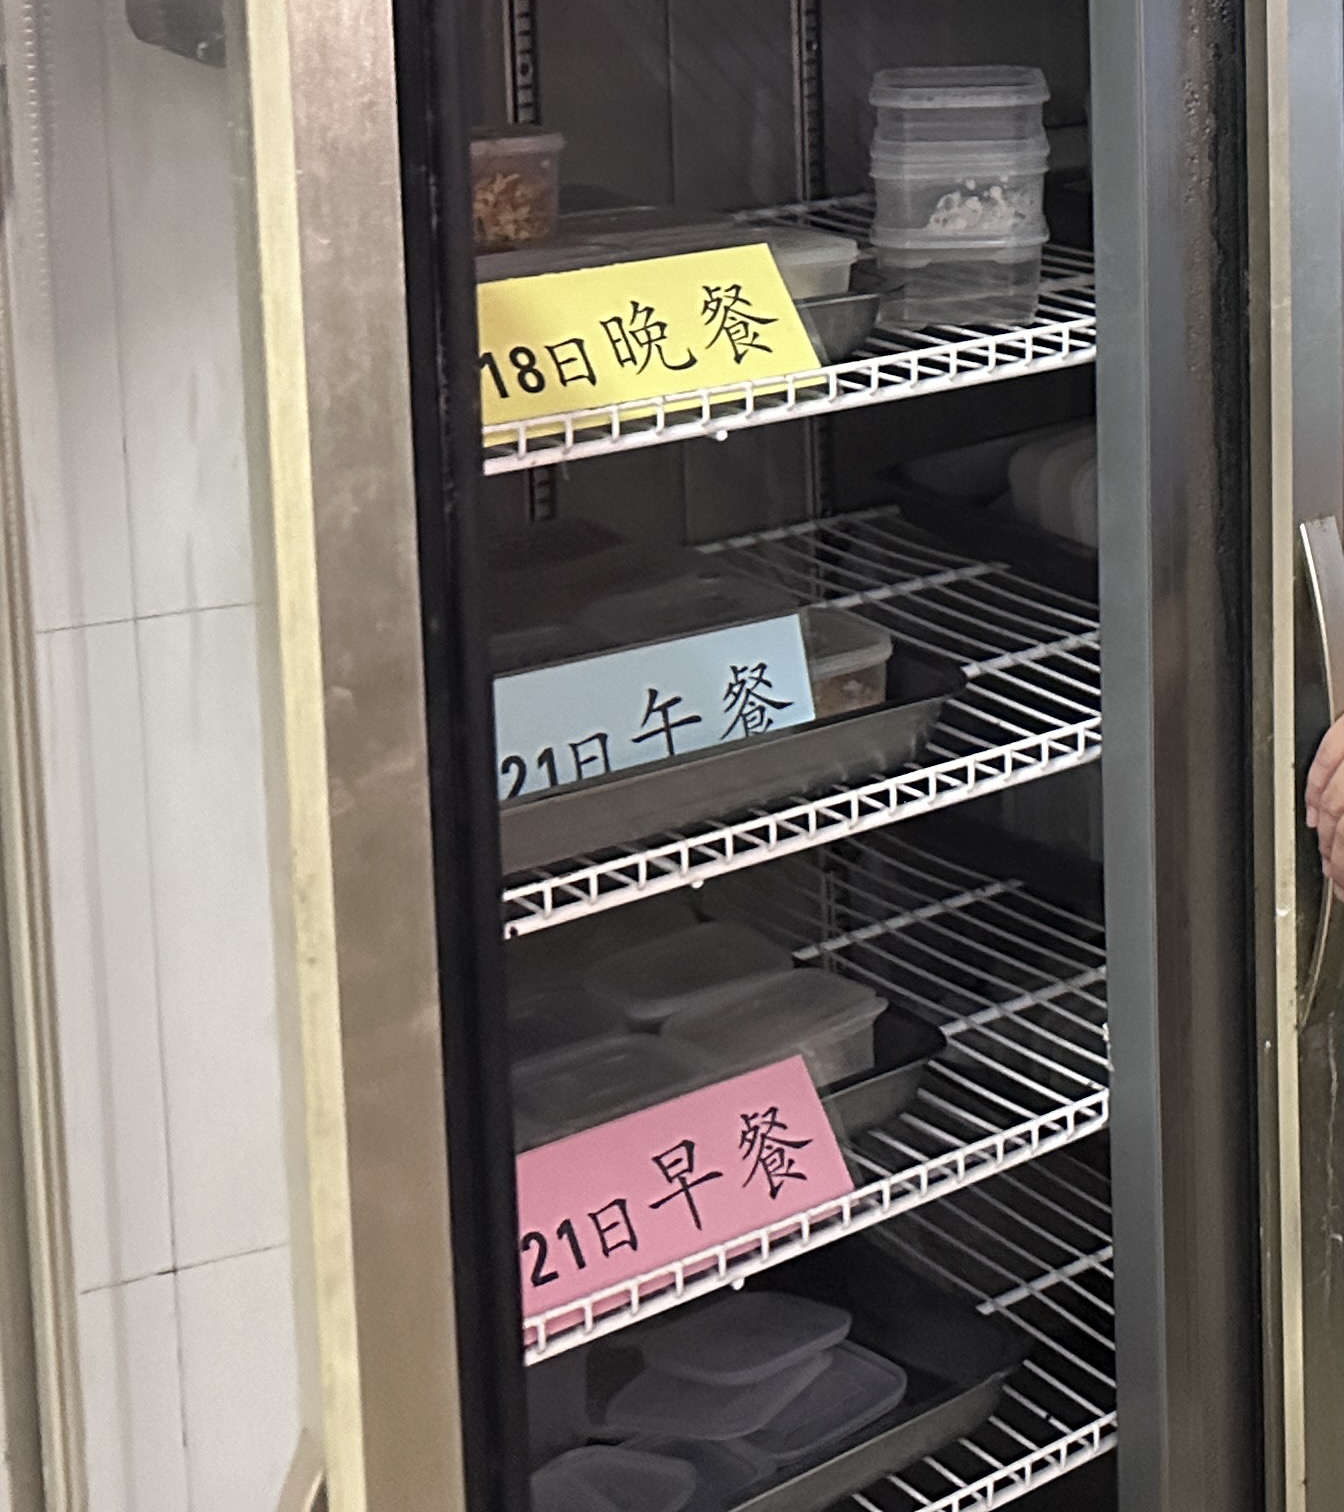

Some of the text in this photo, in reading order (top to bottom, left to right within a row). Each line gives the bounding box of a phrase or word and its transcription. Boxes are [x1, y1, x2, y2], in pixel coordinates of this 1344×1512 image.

[479, 284, 779, 399] 18日晚餐
[521, 1106, 813, 1287] 21日早餐
